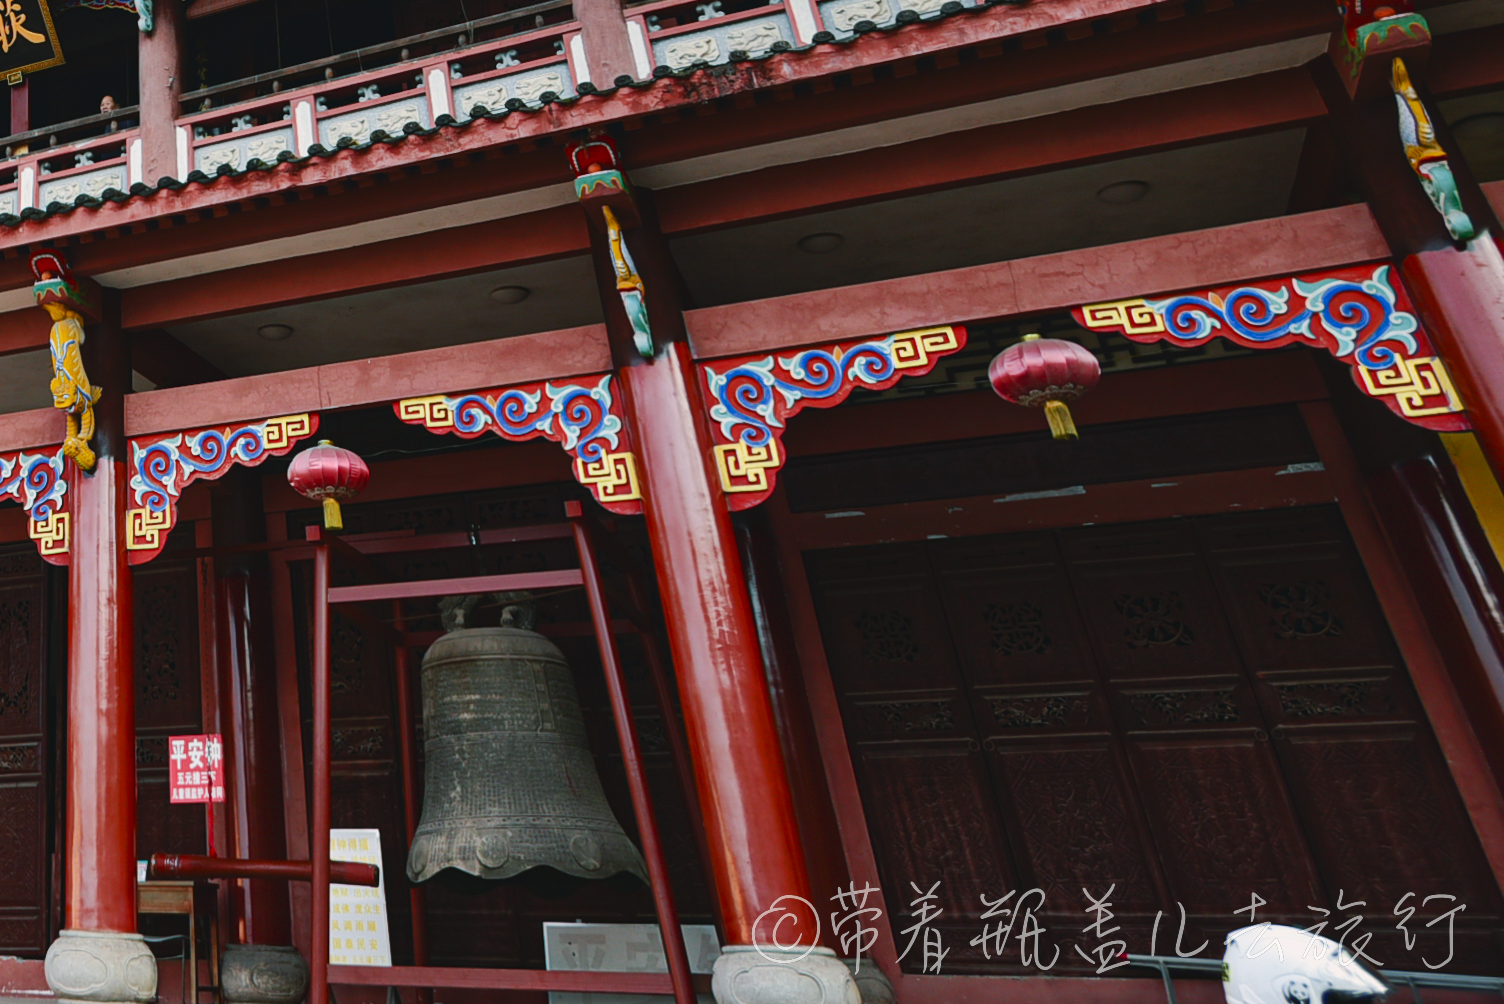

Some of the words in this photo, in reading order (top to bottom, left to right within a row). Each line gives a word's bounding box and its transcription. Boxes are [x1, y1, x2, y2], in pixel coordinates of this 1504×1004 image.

[171, 737, 222, 770] 平安钟
[332, 920, 377, 932] 风调雨顺
[333, 937, 378, 951] 国泰民安
